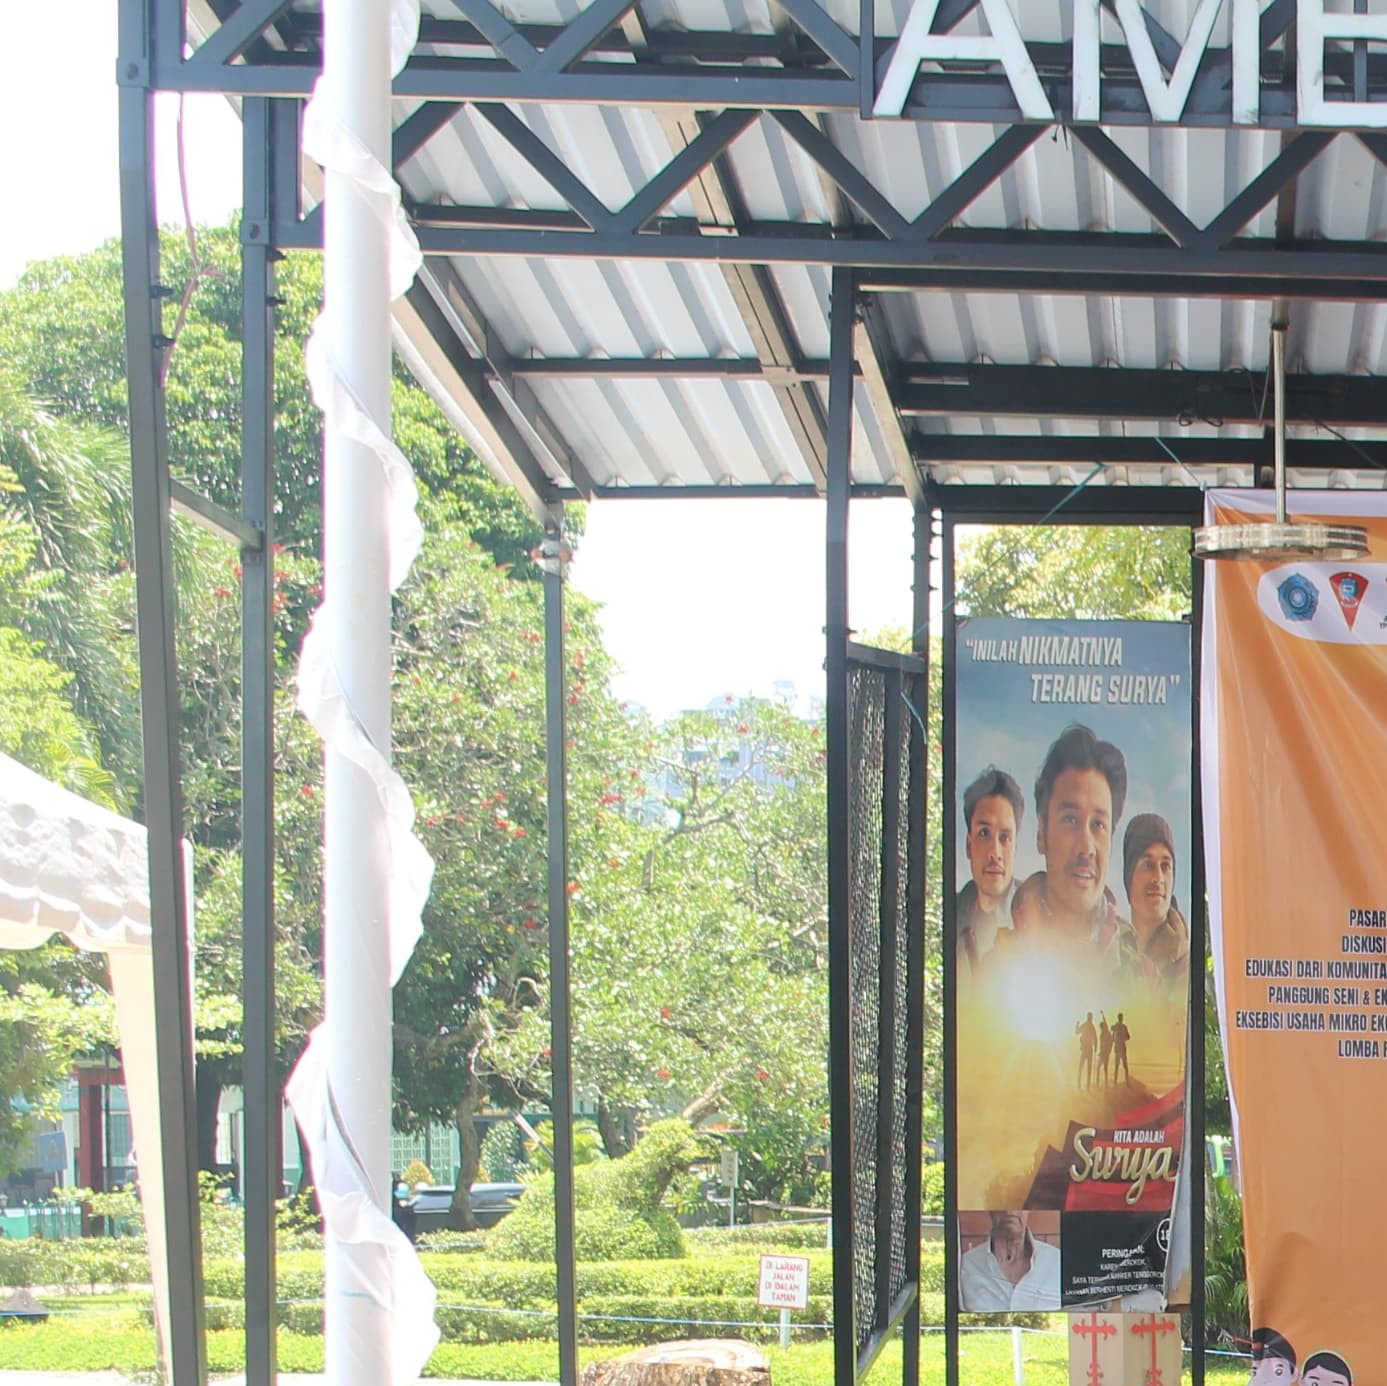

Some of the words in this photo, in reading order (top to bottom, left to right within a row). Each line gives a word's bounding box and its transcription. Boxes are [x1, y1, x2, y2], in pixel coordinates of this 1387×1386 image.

[1018, 635, 1123, 666] NIKMATNYA
[1031, 674, 1103, 703] TERANG
[1350, 909, 1387, 928] PASAR
[1342, 935, 1387, 954] DISKUSI
[1245, 959, 1292, 977] EDUKASI
[1297, 960, 1322, 978] DARI
[1268, 986, 1329, 1004] PANGGUNG
[1333, 987, 1359, 1005] SENI
[1362, 991, 1370, 1006] &
[1236, 1010, 1283, 1029] EKSEBISI
[1287, 1012, 1325, 1030] USAHA
[1329, 1013, 1367, 1031] MIKRO
[1338, 1039, 1379, 1058] LOMBA
[1113, 1130, 1132, 1144] KITA
[1133, 1130, 1165, 1144] ADALAH
[1069, 1127, 1177, 1205] Surya
